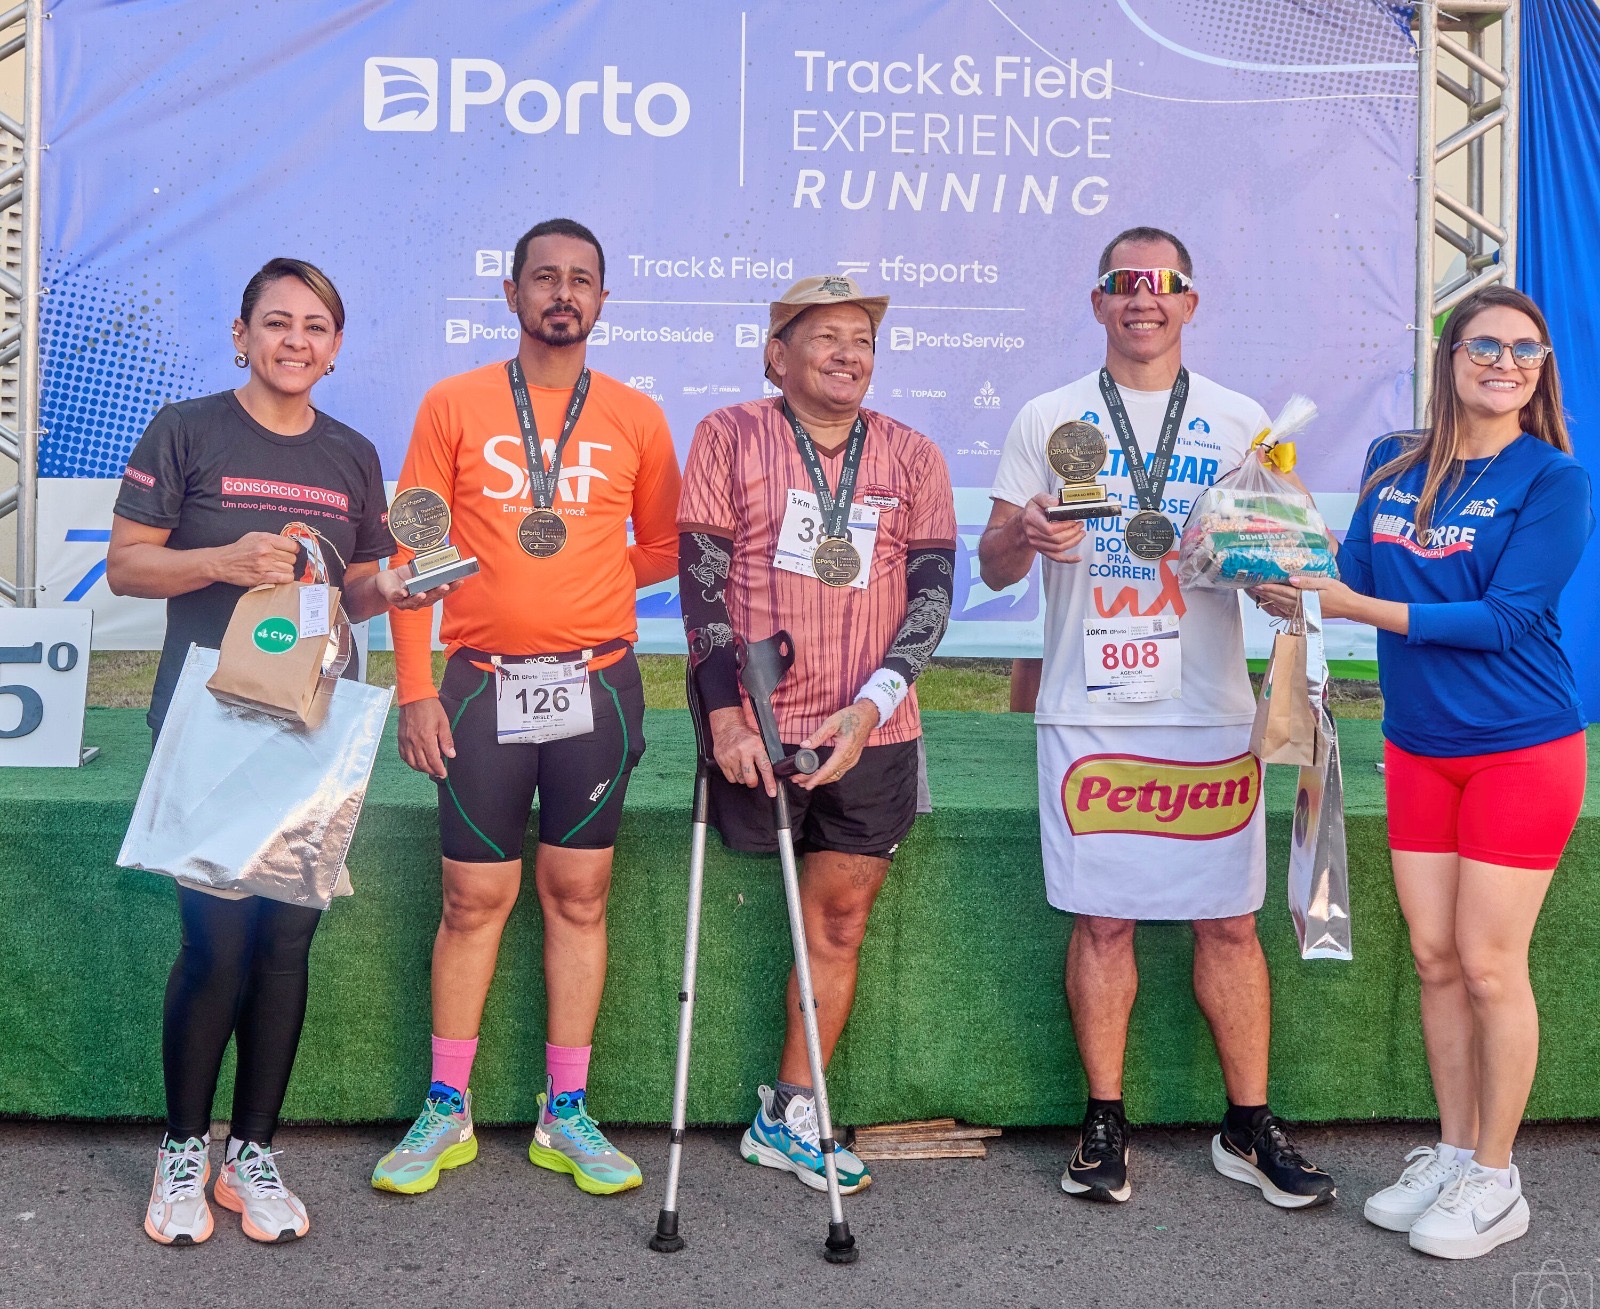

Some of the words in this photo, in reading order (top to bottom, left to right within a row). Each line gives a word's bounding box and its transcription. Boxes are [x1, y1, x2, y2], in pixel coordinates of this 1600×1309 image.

[795, 51, 944, 96] Track
[998, 54, 1114, 101] Field
[450, 58, 690, 137] Porto
[792, 110, 1112, 160] EXPERIENCE
[792, 169, 1110, 216] RUNNING
[629, 254, 705, 278] Track
[731, 257, 793, 280] Field
[879, 256, 998, 287] tfsports
[472, 324, 518, 340] Porto
[911, 388, 946, 398] TOPÁZIO
[974, 396, 1001, 406] CVR
[1194, 437, 1221, 451] Sônia
[482, 435, 612, 503] SAF
[223, 480, 300, 498] CONSÓRCIO
[303, 488, 347, 508] TOYOTA
[1465, 500, 1484, 508] ZIP
[222, 501, 236, 509] Um
[238, 502, 259, 510] novo
[259, 502, 277, 511] jeito
[278, 504, 287, 513] de
[289, 506, 321, 517] comprar
[322, 511, 335, 519] seu
[503, 504, 517, 513] Em
[1107, 553, 1132, 565] PRA
[1088, 563, 1156, 581] CORRER!
[270, 630, 294, 644] CVR
[1086, 628, 1107, 636] 10Km
[1102, 642, 1160, 670] 808
[515, 686, 570, 714] 126
[1076, 775, 1250, 823] Petyan
